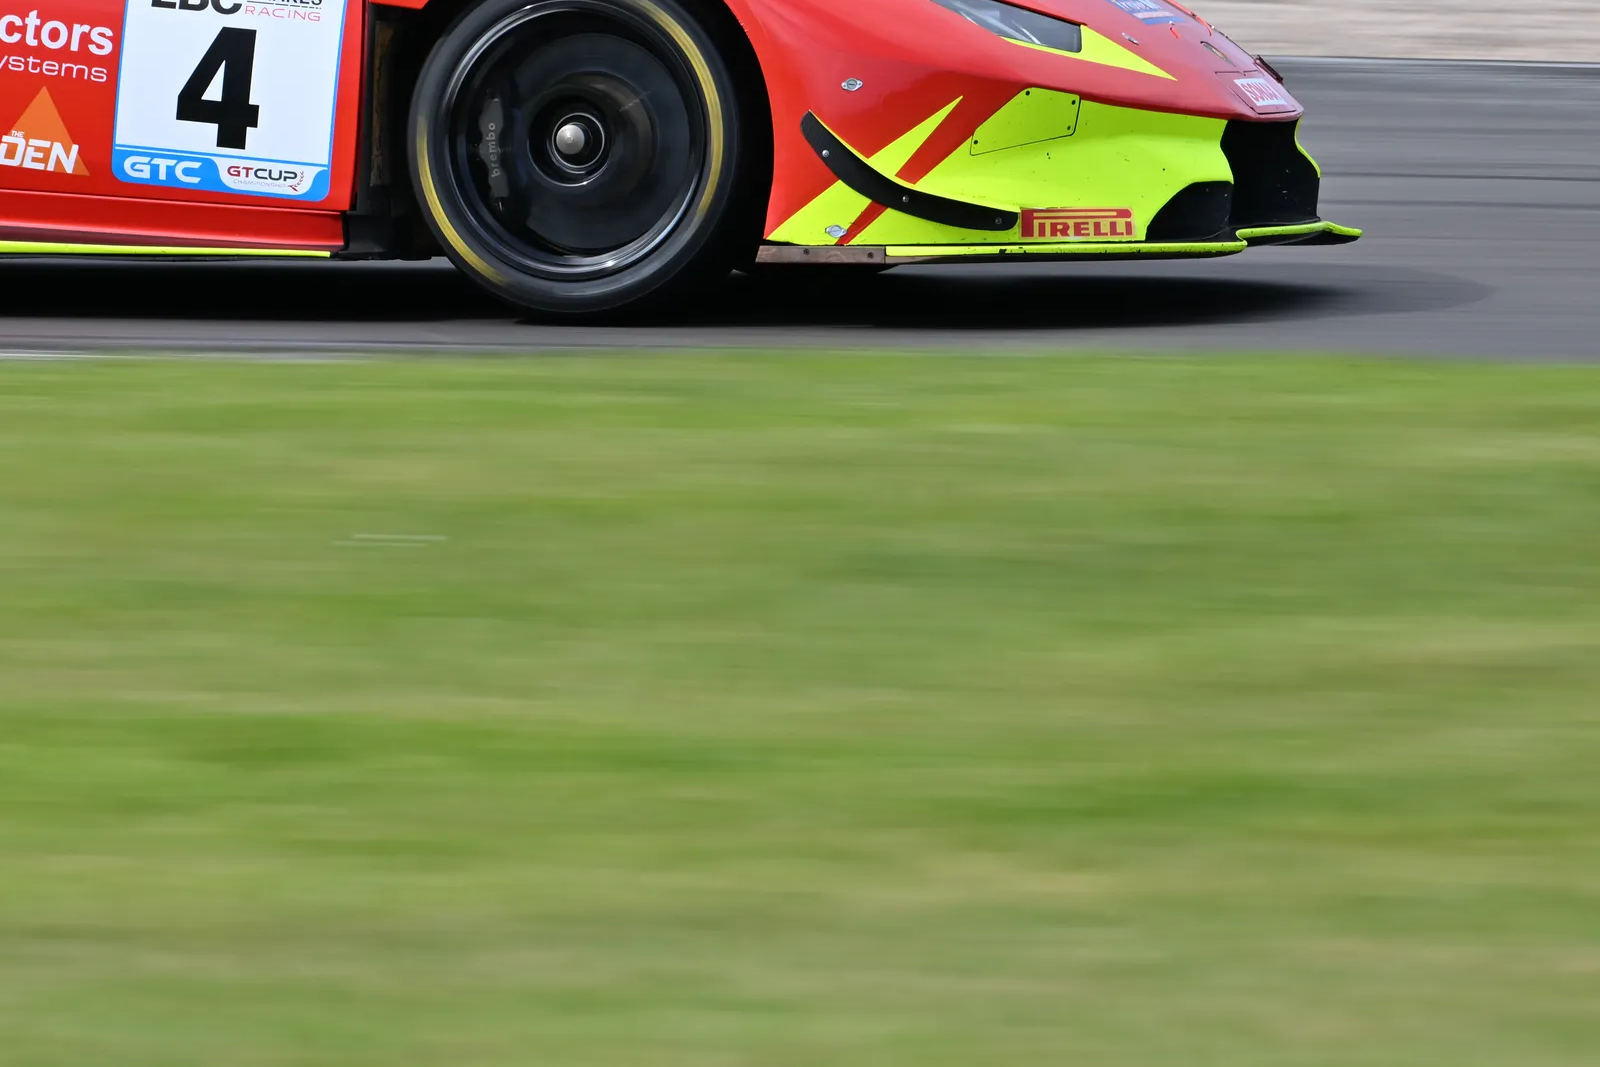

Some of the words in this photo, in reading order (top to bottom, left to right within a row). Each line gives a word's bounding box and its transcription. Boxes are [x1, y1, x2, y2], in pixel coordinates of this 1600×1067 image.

[244, 5, 321, 21] RACING
[176, 26, 260, 150] 4
[11, 129, 25, 138] THE
[485, 122, 501, 178] brembo
[123, 155, 202, 184] GTC
[1021, 208, 1133, 237] PIRELLI
